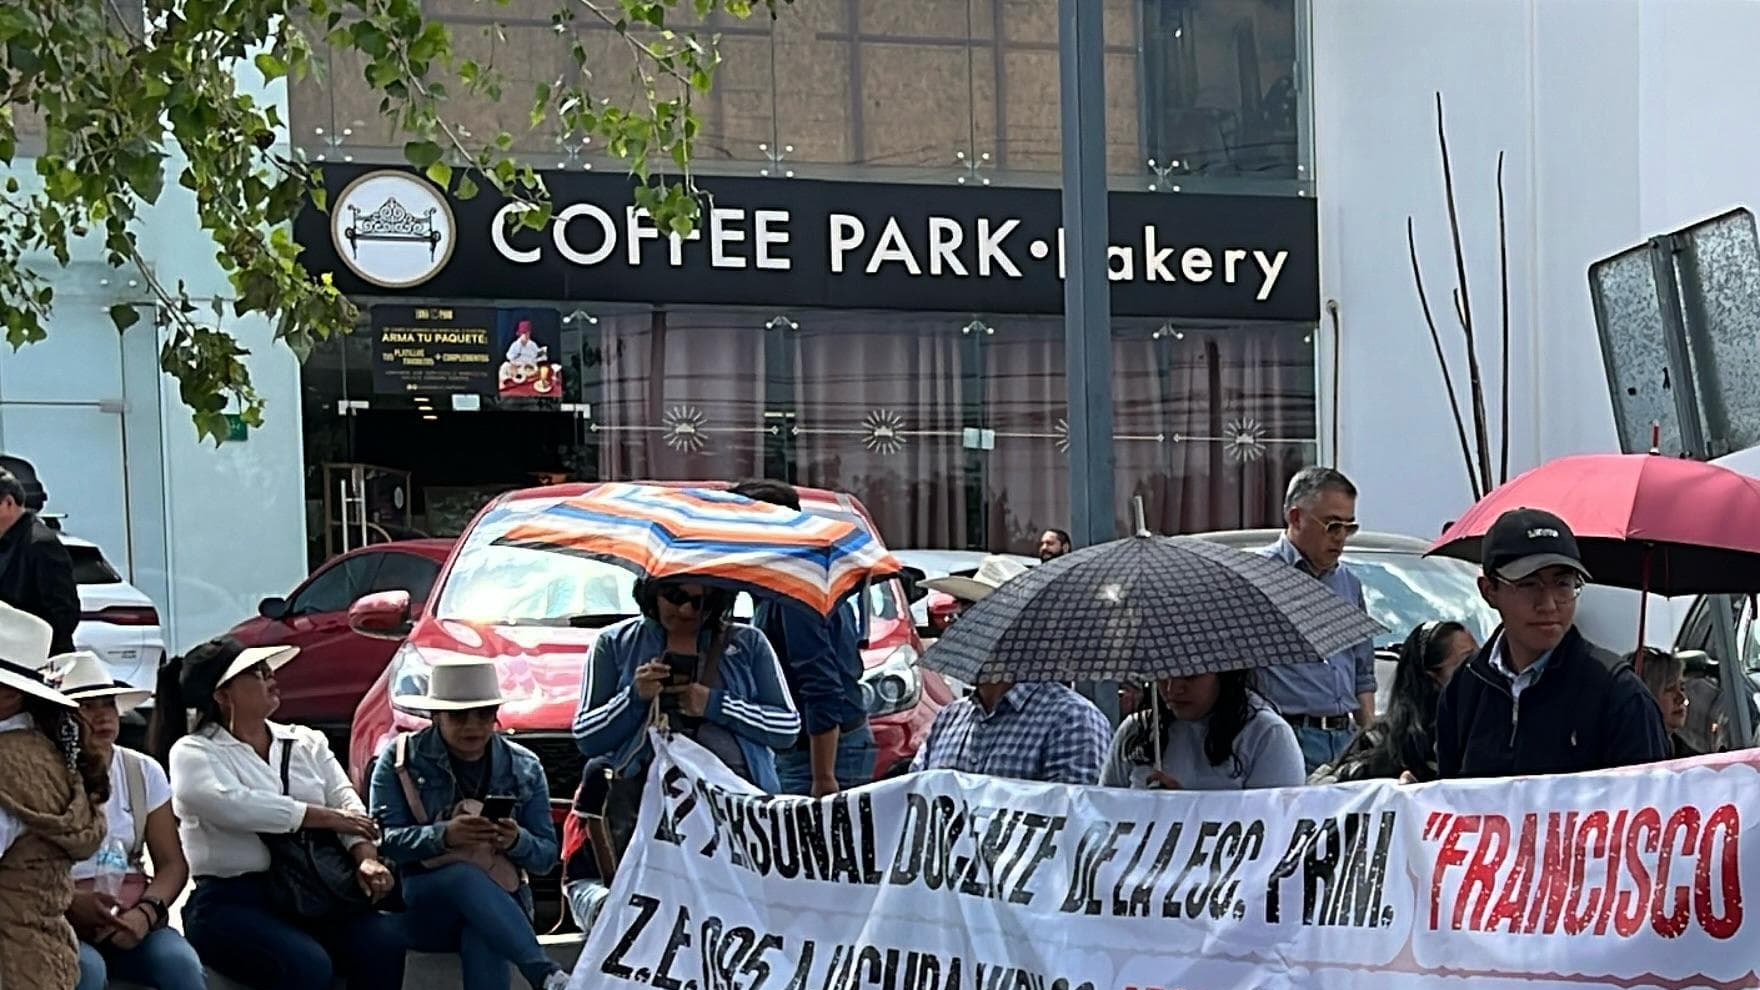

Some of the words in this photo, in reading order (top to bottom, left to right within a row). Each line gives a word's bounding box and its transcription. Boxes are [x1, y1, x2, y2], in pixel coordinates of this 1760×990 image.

[491, 203, 790, 270] COFFEE
[831, 214, 1023, 278] PARK
[382, 334, 415, 343] ARMA
[418, 334, 432, 343] TU
[889, 793, 1067, 905] DOCENTE
[1060, 821, 1136, 915] DE
[1113, 821, 1184, 917] LA
[1163, 819, 1264, 920] ESC.
[1265, 810, 1395, 929] PRIM.
[1422, 803, 1743, 939] "FRANCISCO
